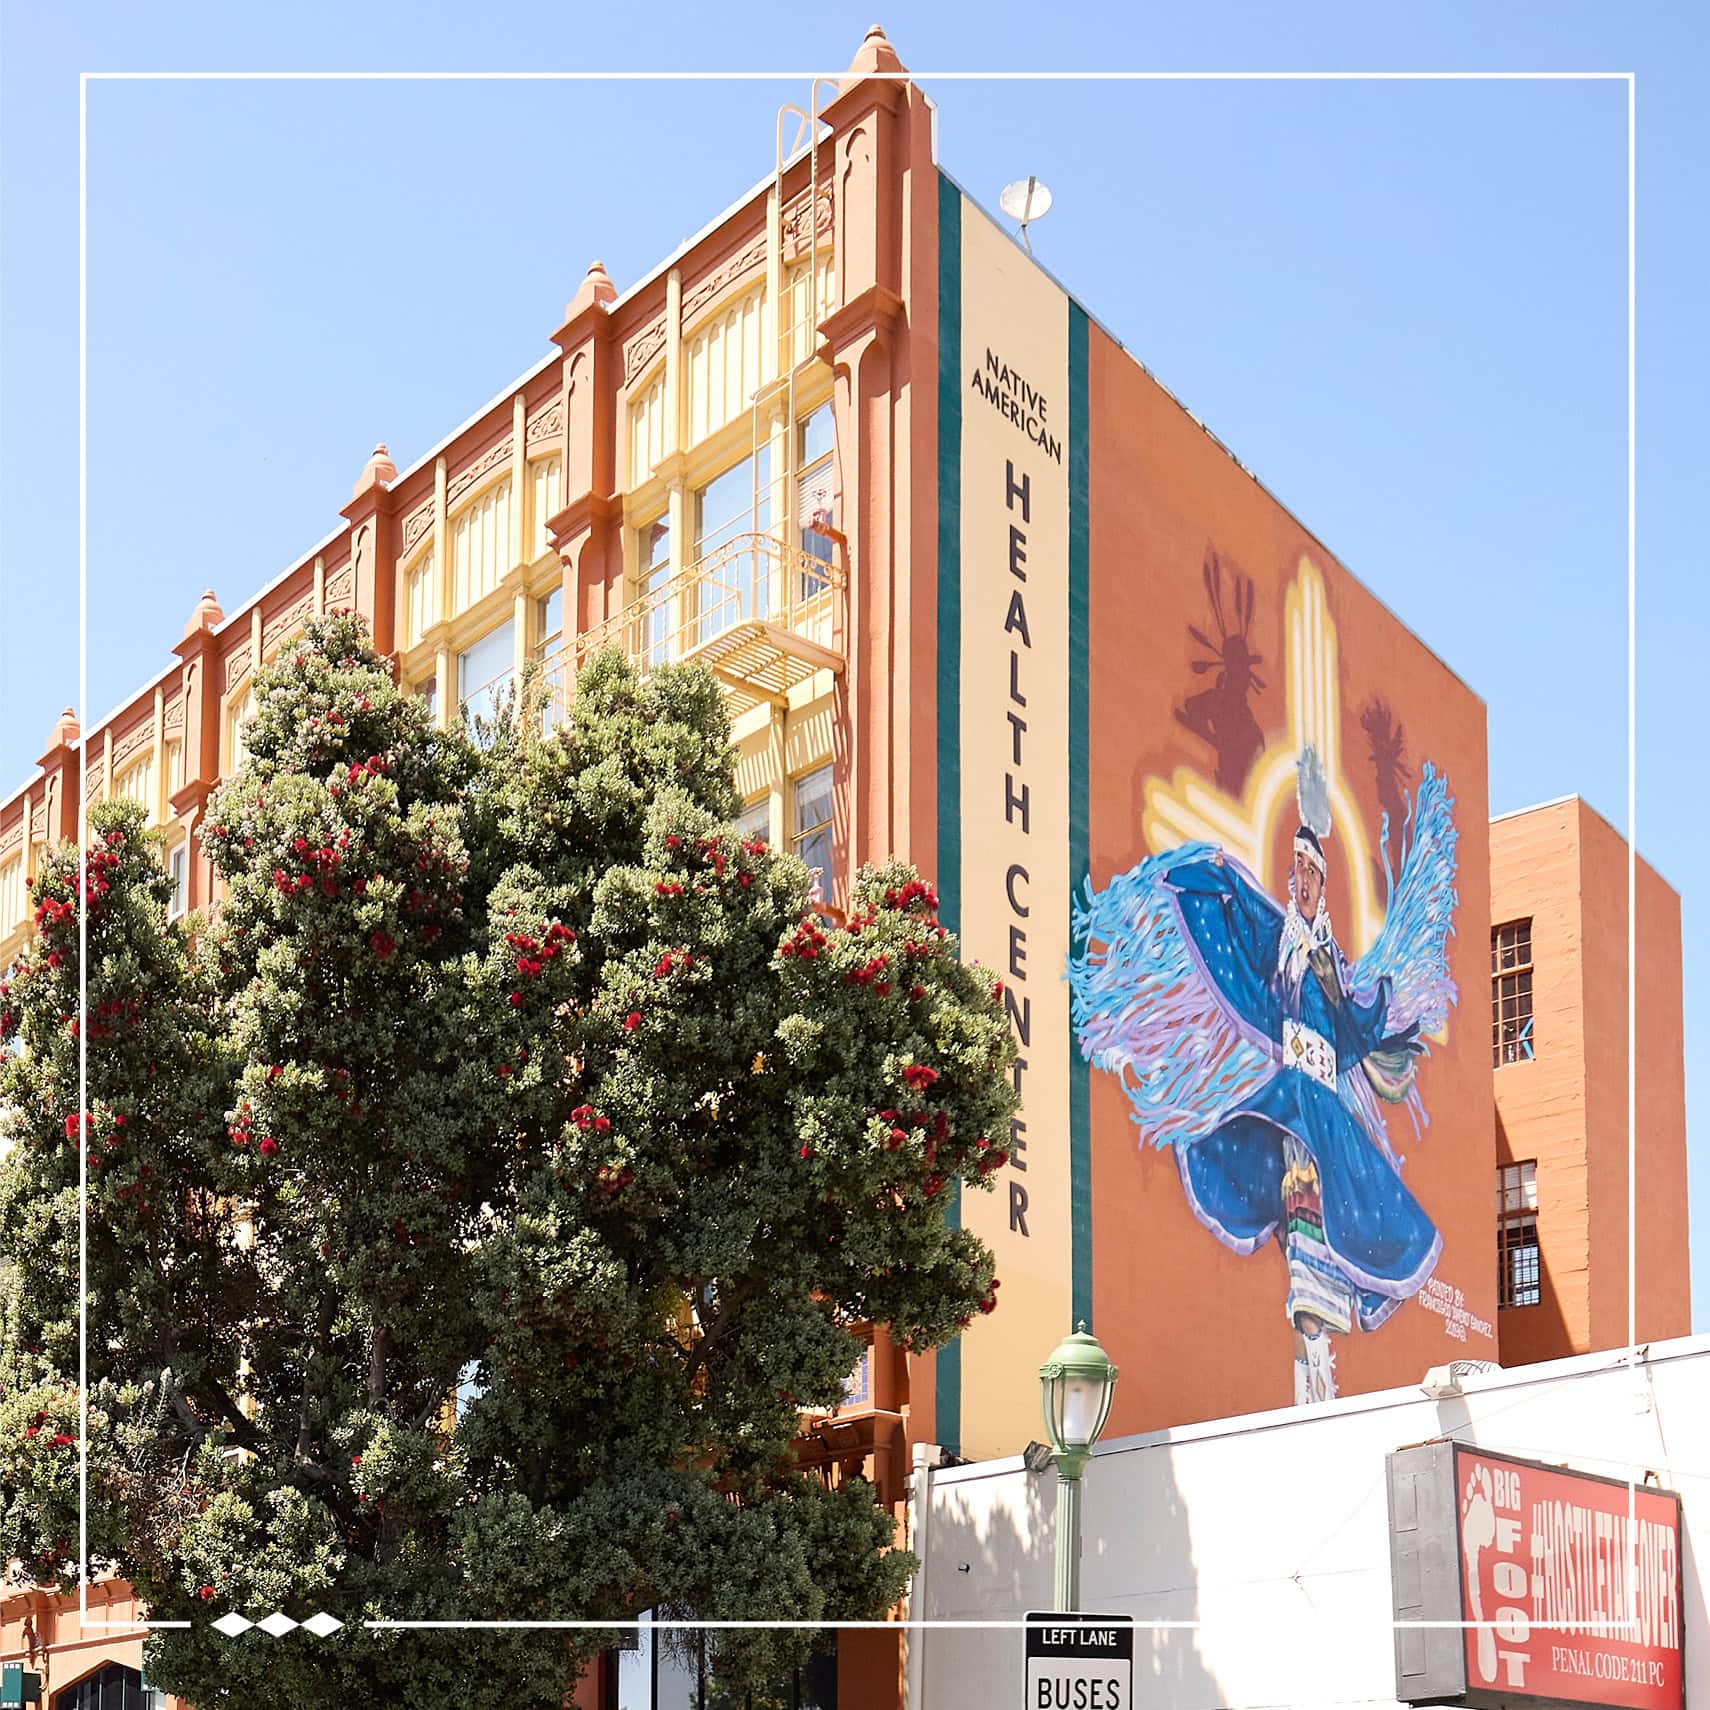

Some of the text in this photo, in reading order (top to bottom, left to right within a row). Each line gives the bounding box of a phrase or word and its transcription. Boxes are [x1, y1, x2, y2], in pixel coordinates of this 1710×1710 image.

[971, 368, 1061, 466] AMERICAN
[986, 347, 1047, 423] NATIVE
[1004, 458, 1032, 835] HEALTH
[1005, 863, 1031, 1237] CENTER
[1493, 1468, 1521, 1512] BIG
[1042, 1628, 1117, 1646] LEFT LANE
[1493, 1516, 1531, 1688] FOOT
[1038, 1677, 1121, 1710] BUSES
[1551, 1646, 1665, 1687] PENAL CODE 211 PC
